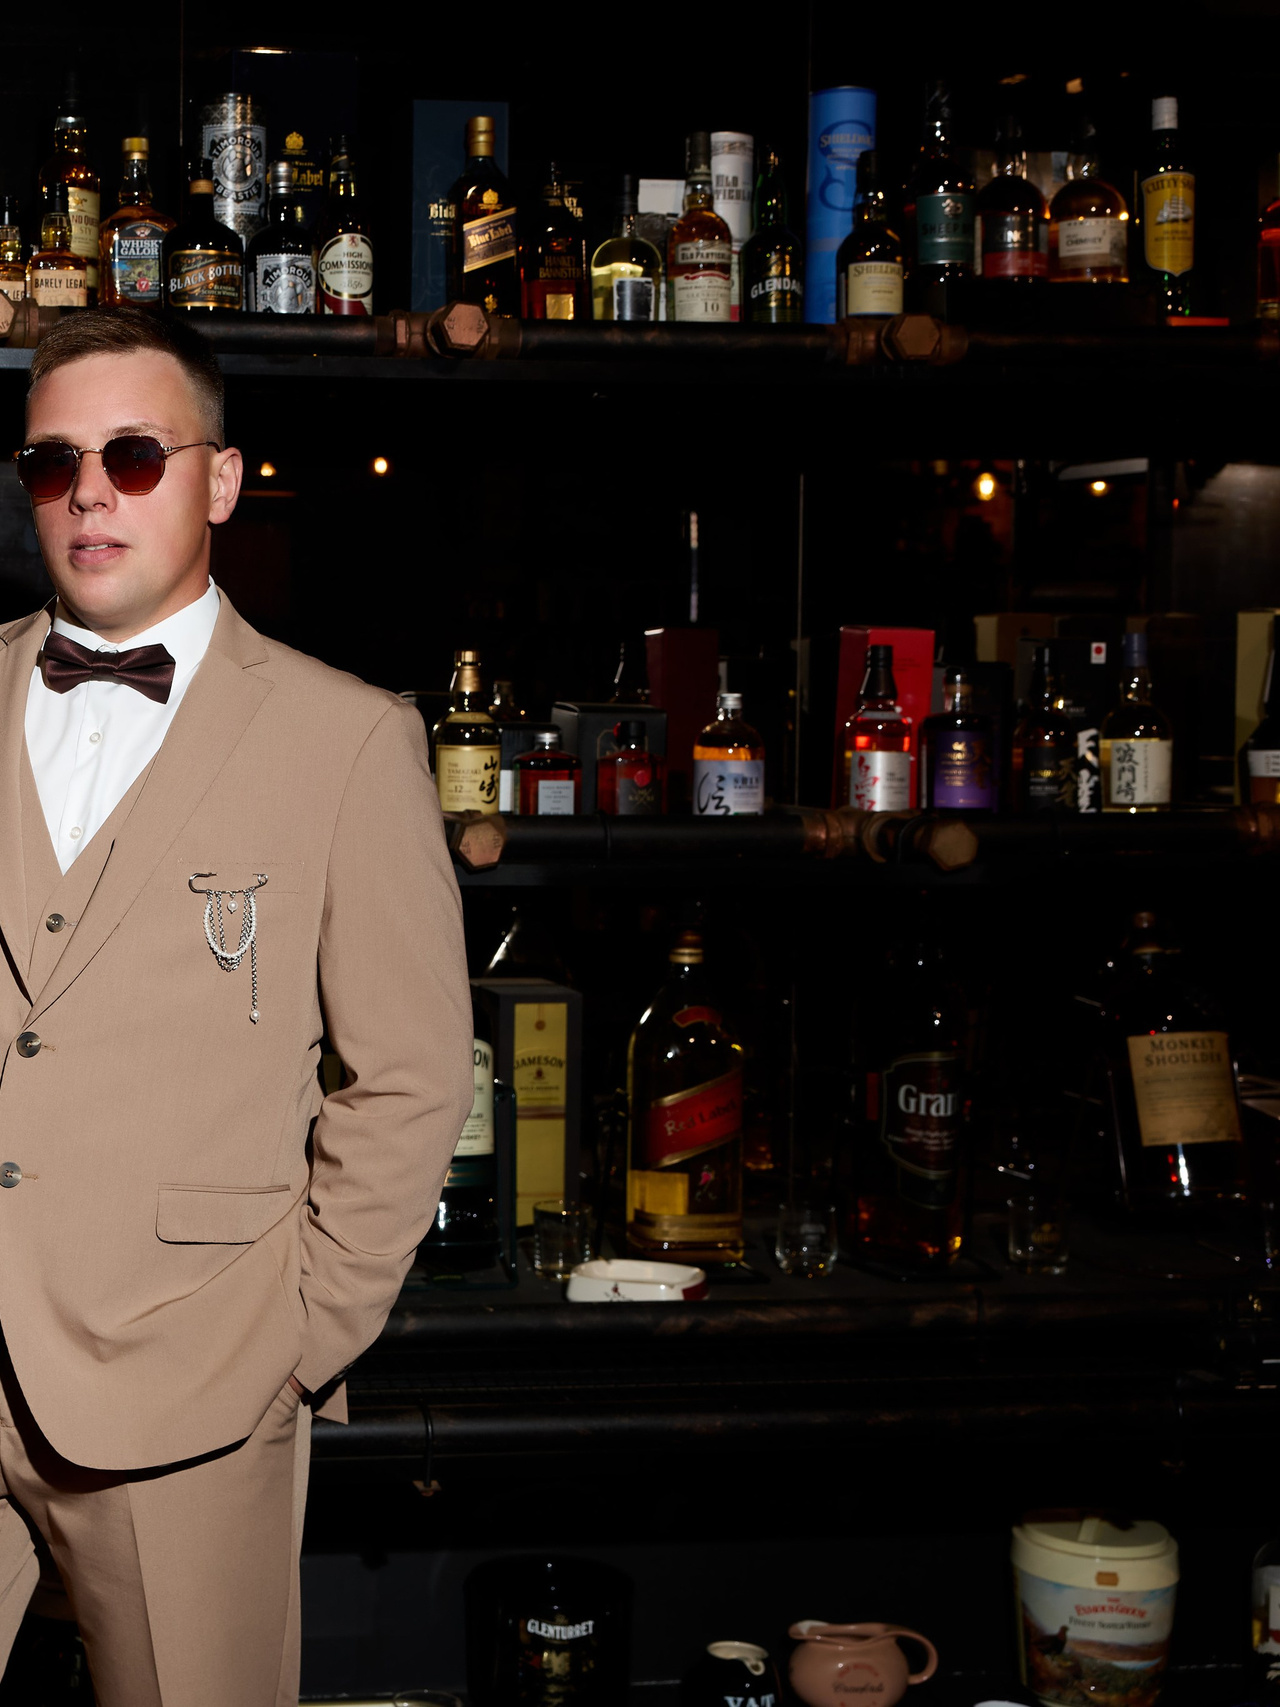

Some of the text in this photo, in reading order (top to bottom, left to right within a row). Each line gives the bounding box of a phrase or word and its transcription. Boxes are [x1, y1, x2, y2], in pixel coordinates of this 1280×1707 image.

[212, 136, 262, 160] TIMOROUS
[214, 180, 260, 202] BEASTIE
[921, 222, 960, 235] SHEEP
[1065, 236, 1103, 247] CHIMNEY
[342, 251, 363, 259] HIGH
[544, 255, 576, 267] HANKEY
[168, 270, 206, 294] BLACK
[206, 263, 242, 281] BOTTLE
[263, 264, 312, 288] TIMOROUS
[538, 267, 583, 280] BANNISTER
[34, 278, 87, 290] BARELY LEGAL
[140, 281, 147, 290] 7
[454, 784, 464, 793] 12
[514, 1056, 565, 1070] JAMESON
[663, 1116, 696, 1137] Red
[526, 1618, 596, 1641] GLENTURRET
